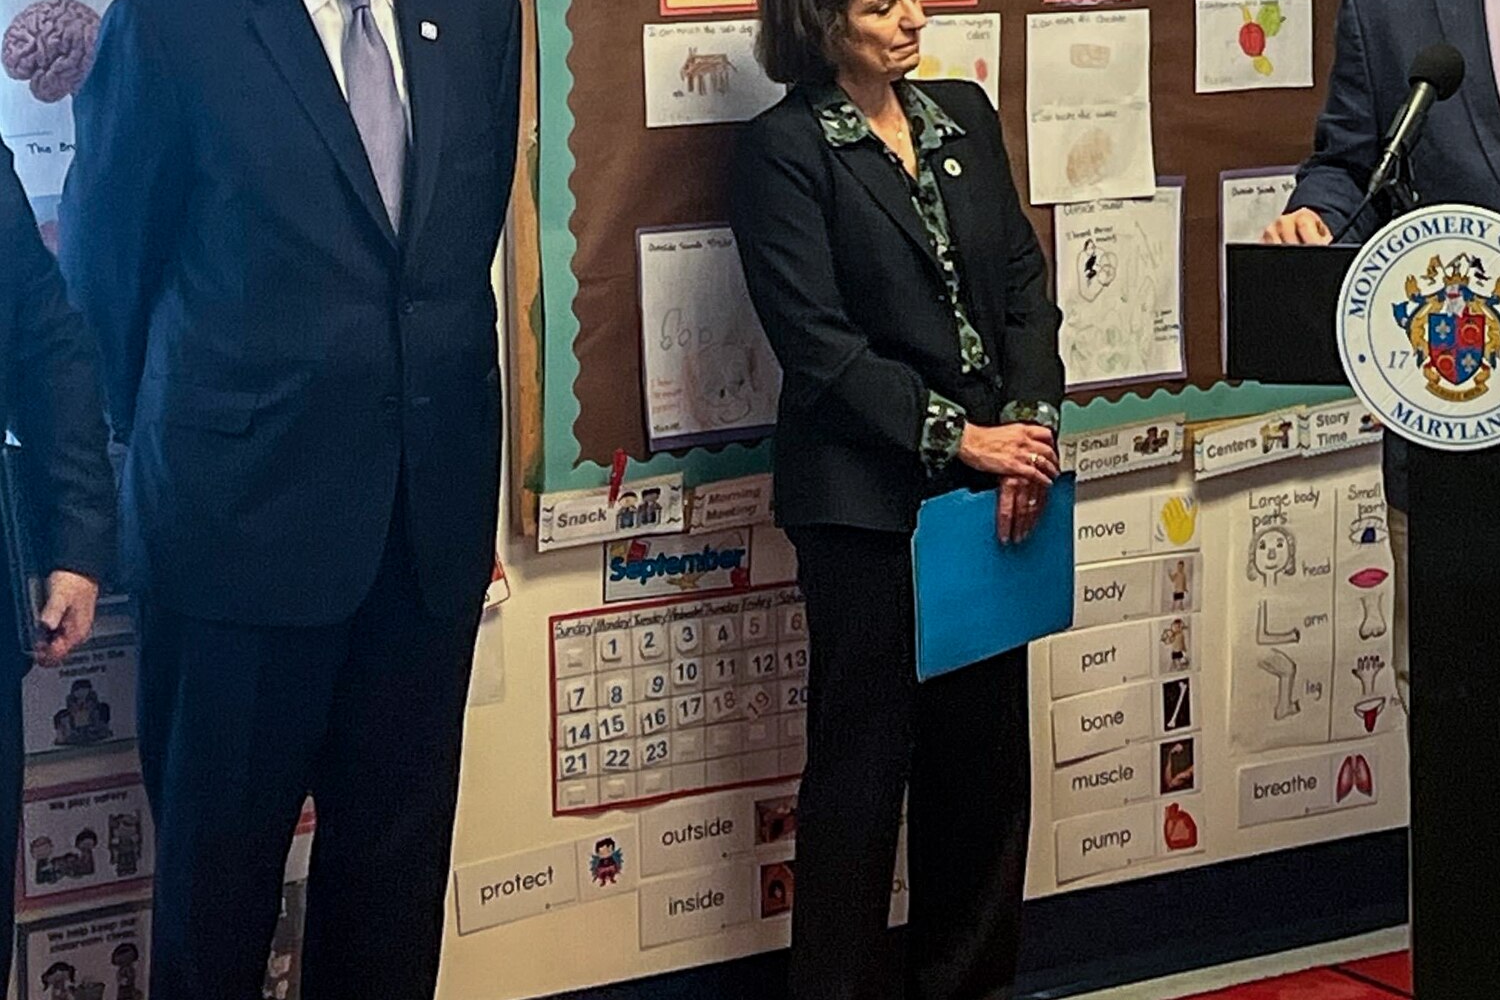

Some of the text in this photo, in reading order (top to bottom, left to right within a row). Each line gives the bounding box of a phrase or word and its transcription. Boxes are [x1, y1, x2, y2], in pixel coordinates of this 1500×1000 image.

[1349, 216, 1492, 318] MONTGOMERY
[1388, 350, 1409, 369] 17
[1316, 411, 1349, 428] Story
[1080, 434, 1118, 451] Small
[1206, 437, 1258, 459] Centers
[1317, 430, 1348, 447] Time
[1079, 451, 1129, 472] Groups
[1249, 489, 1321, 511] Large body
[1348, 484, 1381, 501] Small
[557, 508, 607, 529] Snack
[1078, 521, 1125, 540] move
[610, 544, 745, 585] September
[1303, 562, 1331, 577] head
[1084, 581, 1125, 603] body
[1304, 613, 1328, 628] arm
[608, 612, 801, 655] 1 2 3 4 5 6
[1081, 645, 1117, 671] part
[573, 649, 807, 706] 7 8 9 10 11 12 13
[1305, 679, 1322, 700] leg
[568, 723, 592, 744] 14
[600, 715, 624, 736] 15
[644, 708, 666, 729] 16
[679, 697, 701, 717] 17
[713, 692, 736, 711] 18
[748, 691, 769, 715] 19
[1080, 710, 1125, 732] bone
[565, 740, 668, 773] 21 22 23
[1072, 765, 1134, 791] muscle
[1254, 773, 1317, 799] breathe
[661, 817, 734, 847] outside
[1081, 828, 1131, 855] pump
[480, 866, 554, 904] protect
[668, 890, 725, 917] inside
